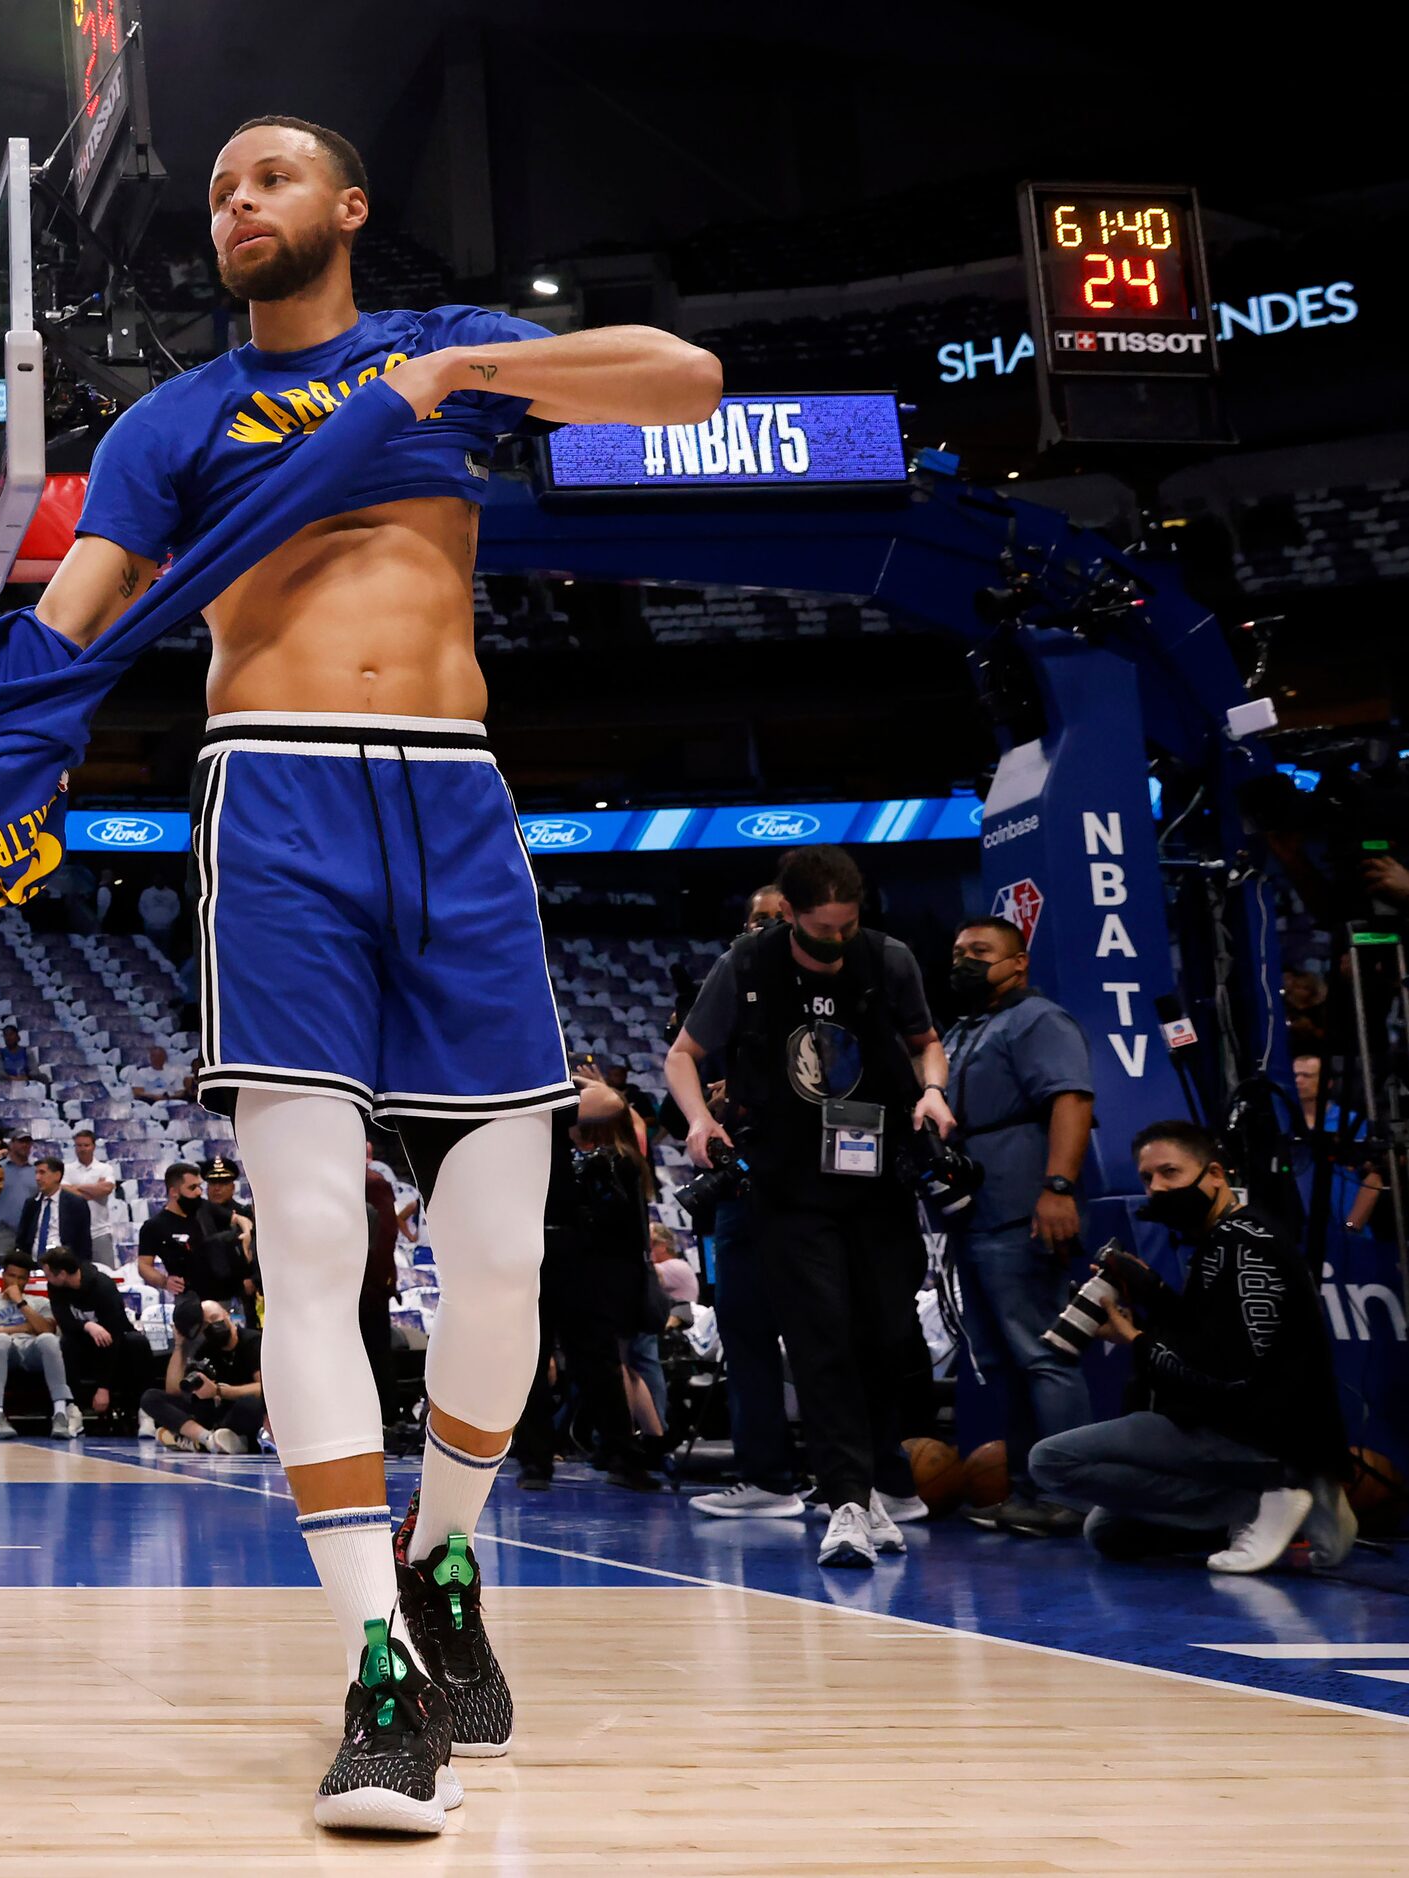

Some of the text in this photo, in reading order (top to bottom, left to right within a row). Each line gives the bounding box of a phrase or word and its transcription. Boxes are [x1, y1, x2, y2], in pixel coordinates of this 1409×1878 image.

[1053, 204, 1173, 250] 61:40
[1083, 253, 1159, 309] 24
[1215, 281, 1360, 342] NDES
[937, 332, 1036, 383] SHA
[1096, 332, 1207, 354] TISSOT
[641, 402, 811, 476] #NBA75
[101, 819, 148, 843] Ford
[525, 822, 576, 845] Ford
[754, 813, 803, 838] Ford
[983, 814, 1040, 849] coinbase
[1082, 811, 1148, 1077] NBA TV
